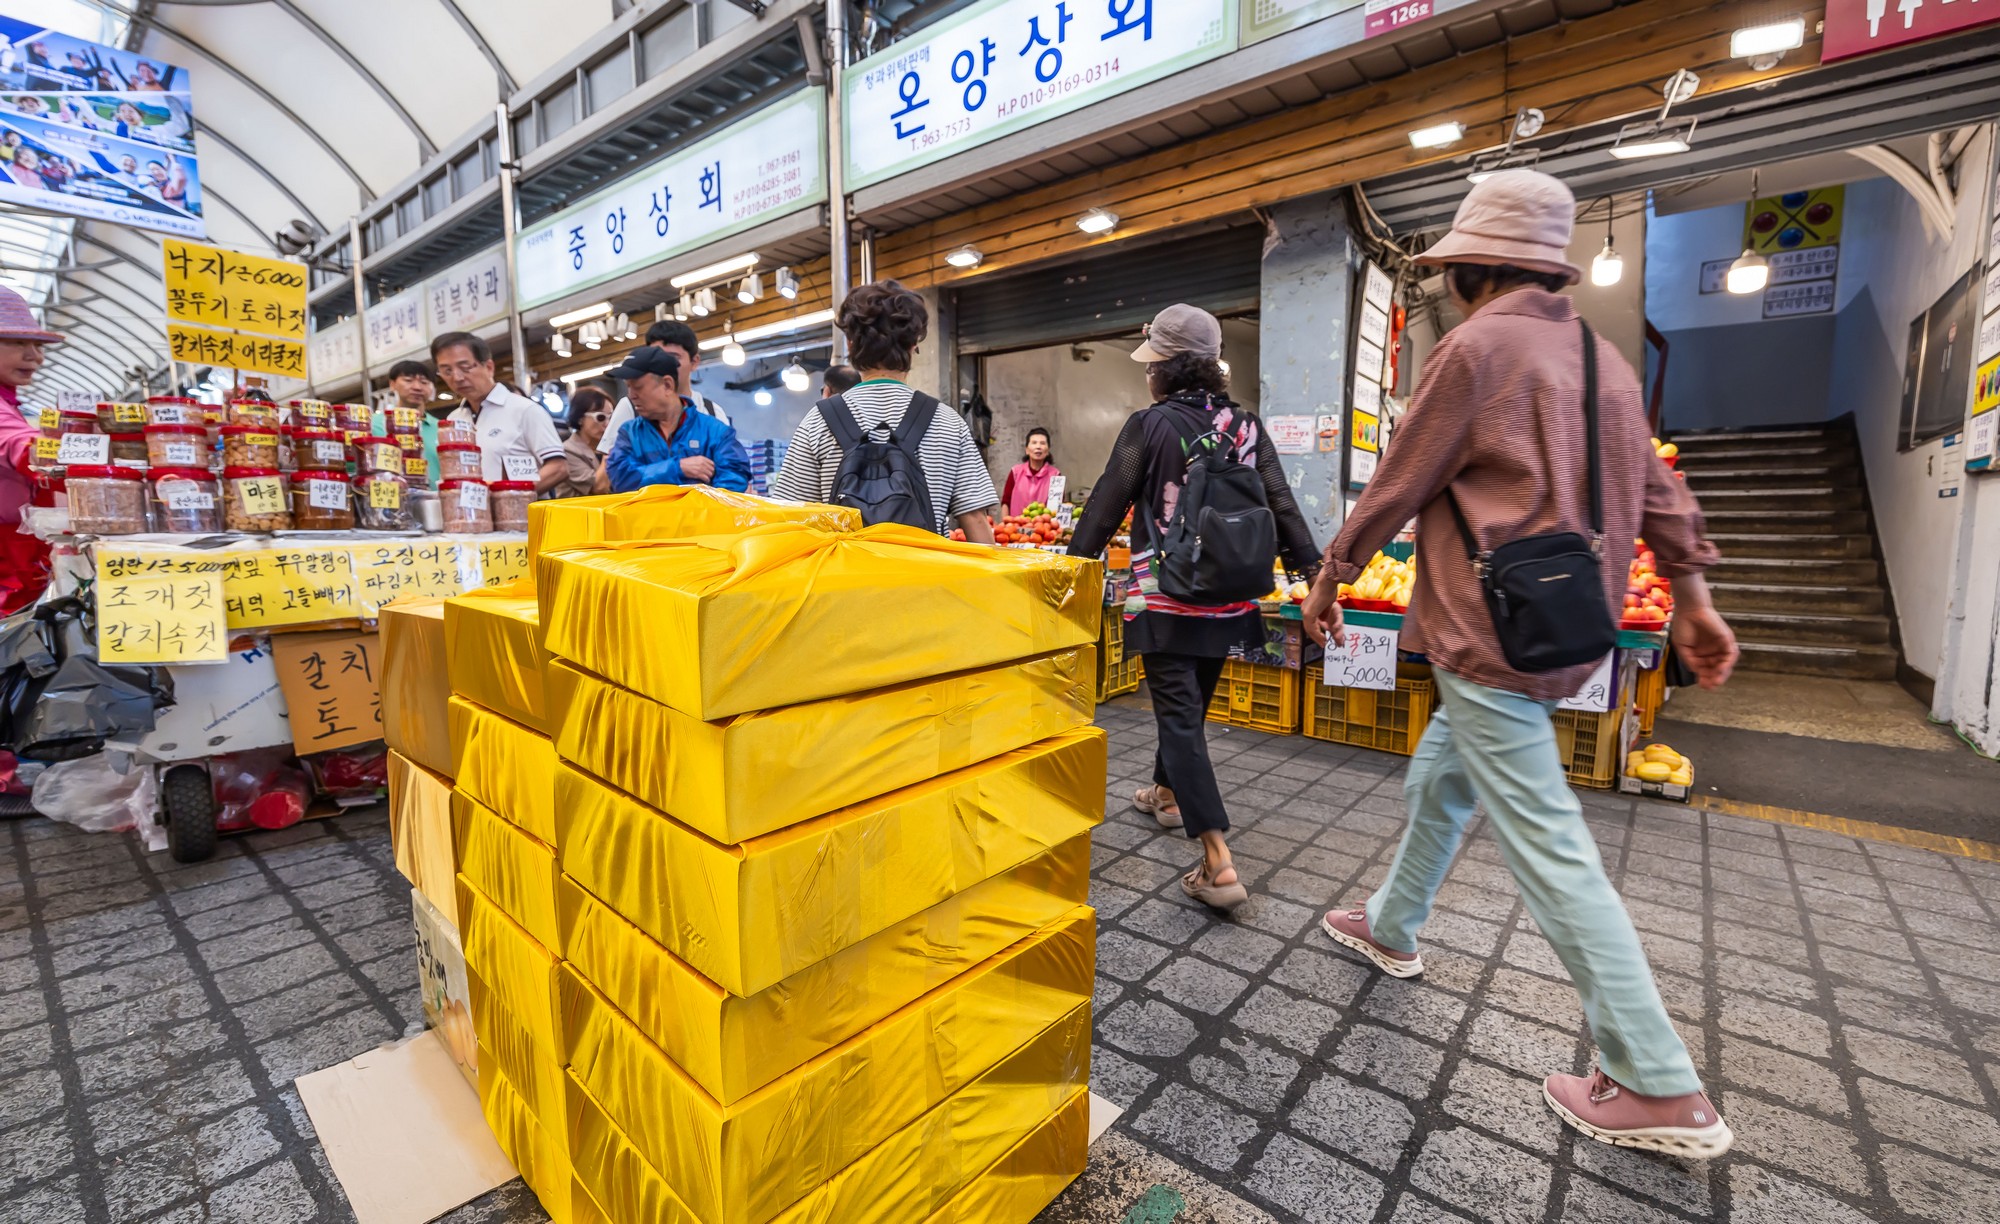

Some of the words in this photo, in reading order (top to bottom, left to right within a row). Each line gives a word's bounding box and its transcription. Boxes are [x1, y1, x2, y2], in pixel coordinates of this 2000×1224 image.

[922, 117, 971, 149] 963-7573
[1020, 57, 1120, 109] 010-9169-0314
[569, 160, 722, 271] 중앙상회
[168, 246, 223, 285] 낙지
[105, 580, 214, 610] 조개젓
[104, 619, 217, 655] 갈치속젓
[300, 643, 373, 690] 갈치
